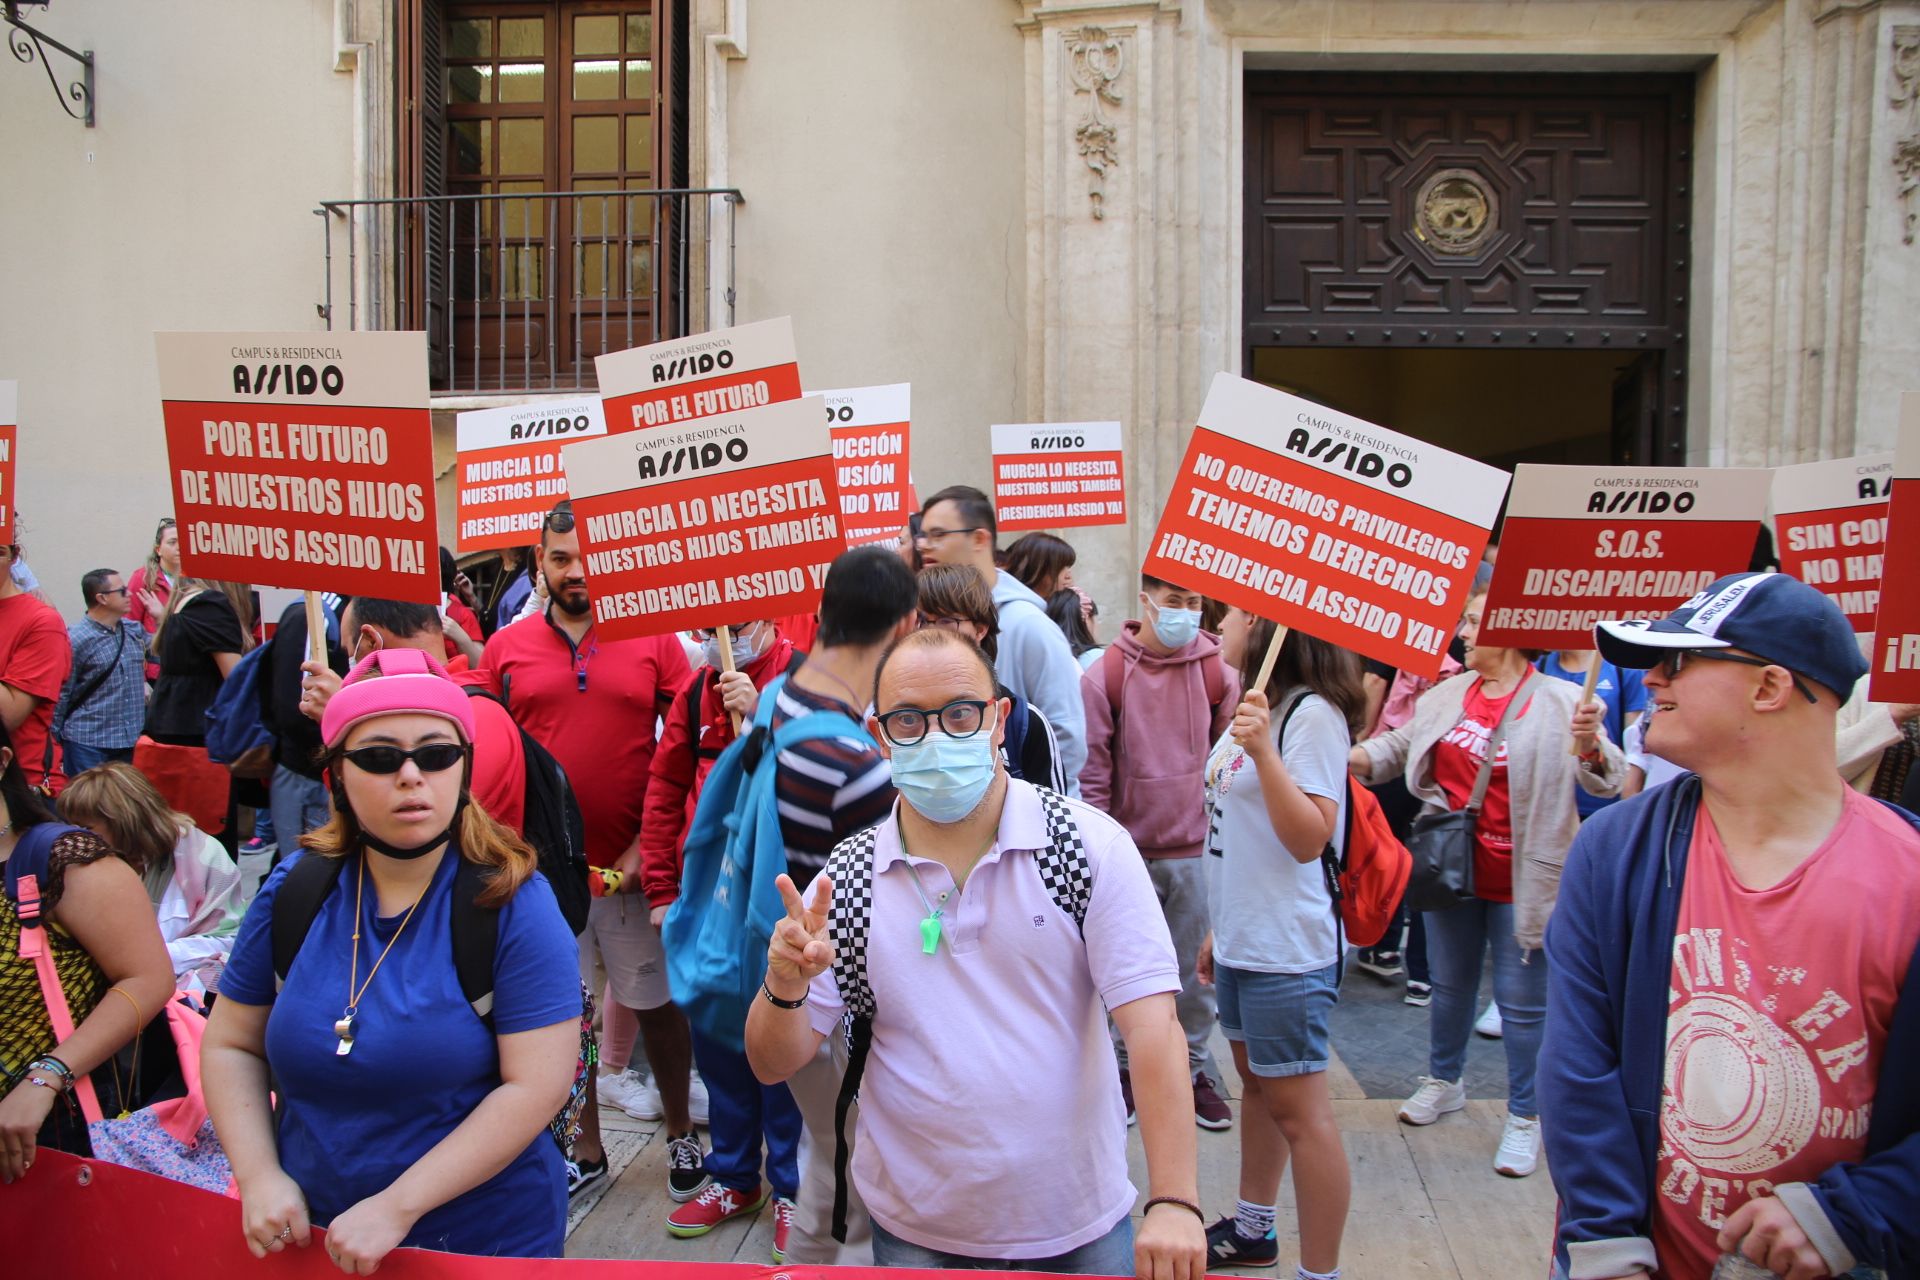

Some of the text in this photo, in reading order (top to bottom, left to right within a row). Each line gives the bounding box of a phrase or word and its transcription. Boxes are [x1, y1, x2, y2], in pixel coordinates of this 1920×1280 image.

[231, 347, 342, 360] CAMPUS & RESIDENCIA
[650, 350, 679, 361] CAMPUS
[687, 339, 731, 354] RESIDENCIA
[233, 364, 344, 396] ASSIDO
[653, 350, 733, 383] ASSIDO
[632, 380, 769, 428] POR EL FUTURO
[203, 420, 388, 466] POR EL FUTURO
[511, 415, 590, 440] ASSIDO
[636, 423, 745, 452] CAMPUS & RESIDENCIA
[1031, 436, 1085, 449] ASSIDO
[1297, 412, 1419, 465] CAMPUS & RESIDENCIA
[466, 454, 531, 484] MURCIA
[535, 453, 554, 475] LO
[638, 437, 748, 479] ASSIDO
[1000, 460, 1118, 479] MURCIA LO NECESITA
[1285, 427, 1412, 488] ASSIDO
[180, 469, 424, 523] DE NUESTROS HIJOS
[462, 478, 569, 506] NUESTROS HIJO
[997, 477, 1121, 496] NUESTROS HIJOS TAMBIÉN
[1594, 478, 1699, 489] CAMPUS & RESIDENCIA
[586, 478, 827, 544] MURCIA LO NECESITA
[873, 491, 900, 513] YA!
[999, 501, 1122, 522] ¡RESIDENCIA ASSIDO YA!
[1193, 453, 1470, 571] NO QUEREMOS PRIVILEGIOS
[1587, 491, 1696, 513] ASSIDO
[189, 521, 426, 575] ¡CAMPUS ASSIDO YA!
[587, 513, 838, 577] NUESTROS HIJOS TAMBIÉN
[1186, 488, 1451, 607] TENEMOS DERECHOS
[1595, 529, 1664, 559] S.O.S.
[1787, 523, 1835, 552] SIN
[1522, 568, 1716, 597] DISCAPACIDAD
[1802, 553, 1883, 584] NO HA
[595, 578, 723, 624] ¡RESIDENCIA
[724, 568, 805, 603] ASSIDO
[1156, 532, 1445, 656] ¡RESIDENCIA ASSIDO YA!
[1699, 584, 1747, 625] JERUSALEM
